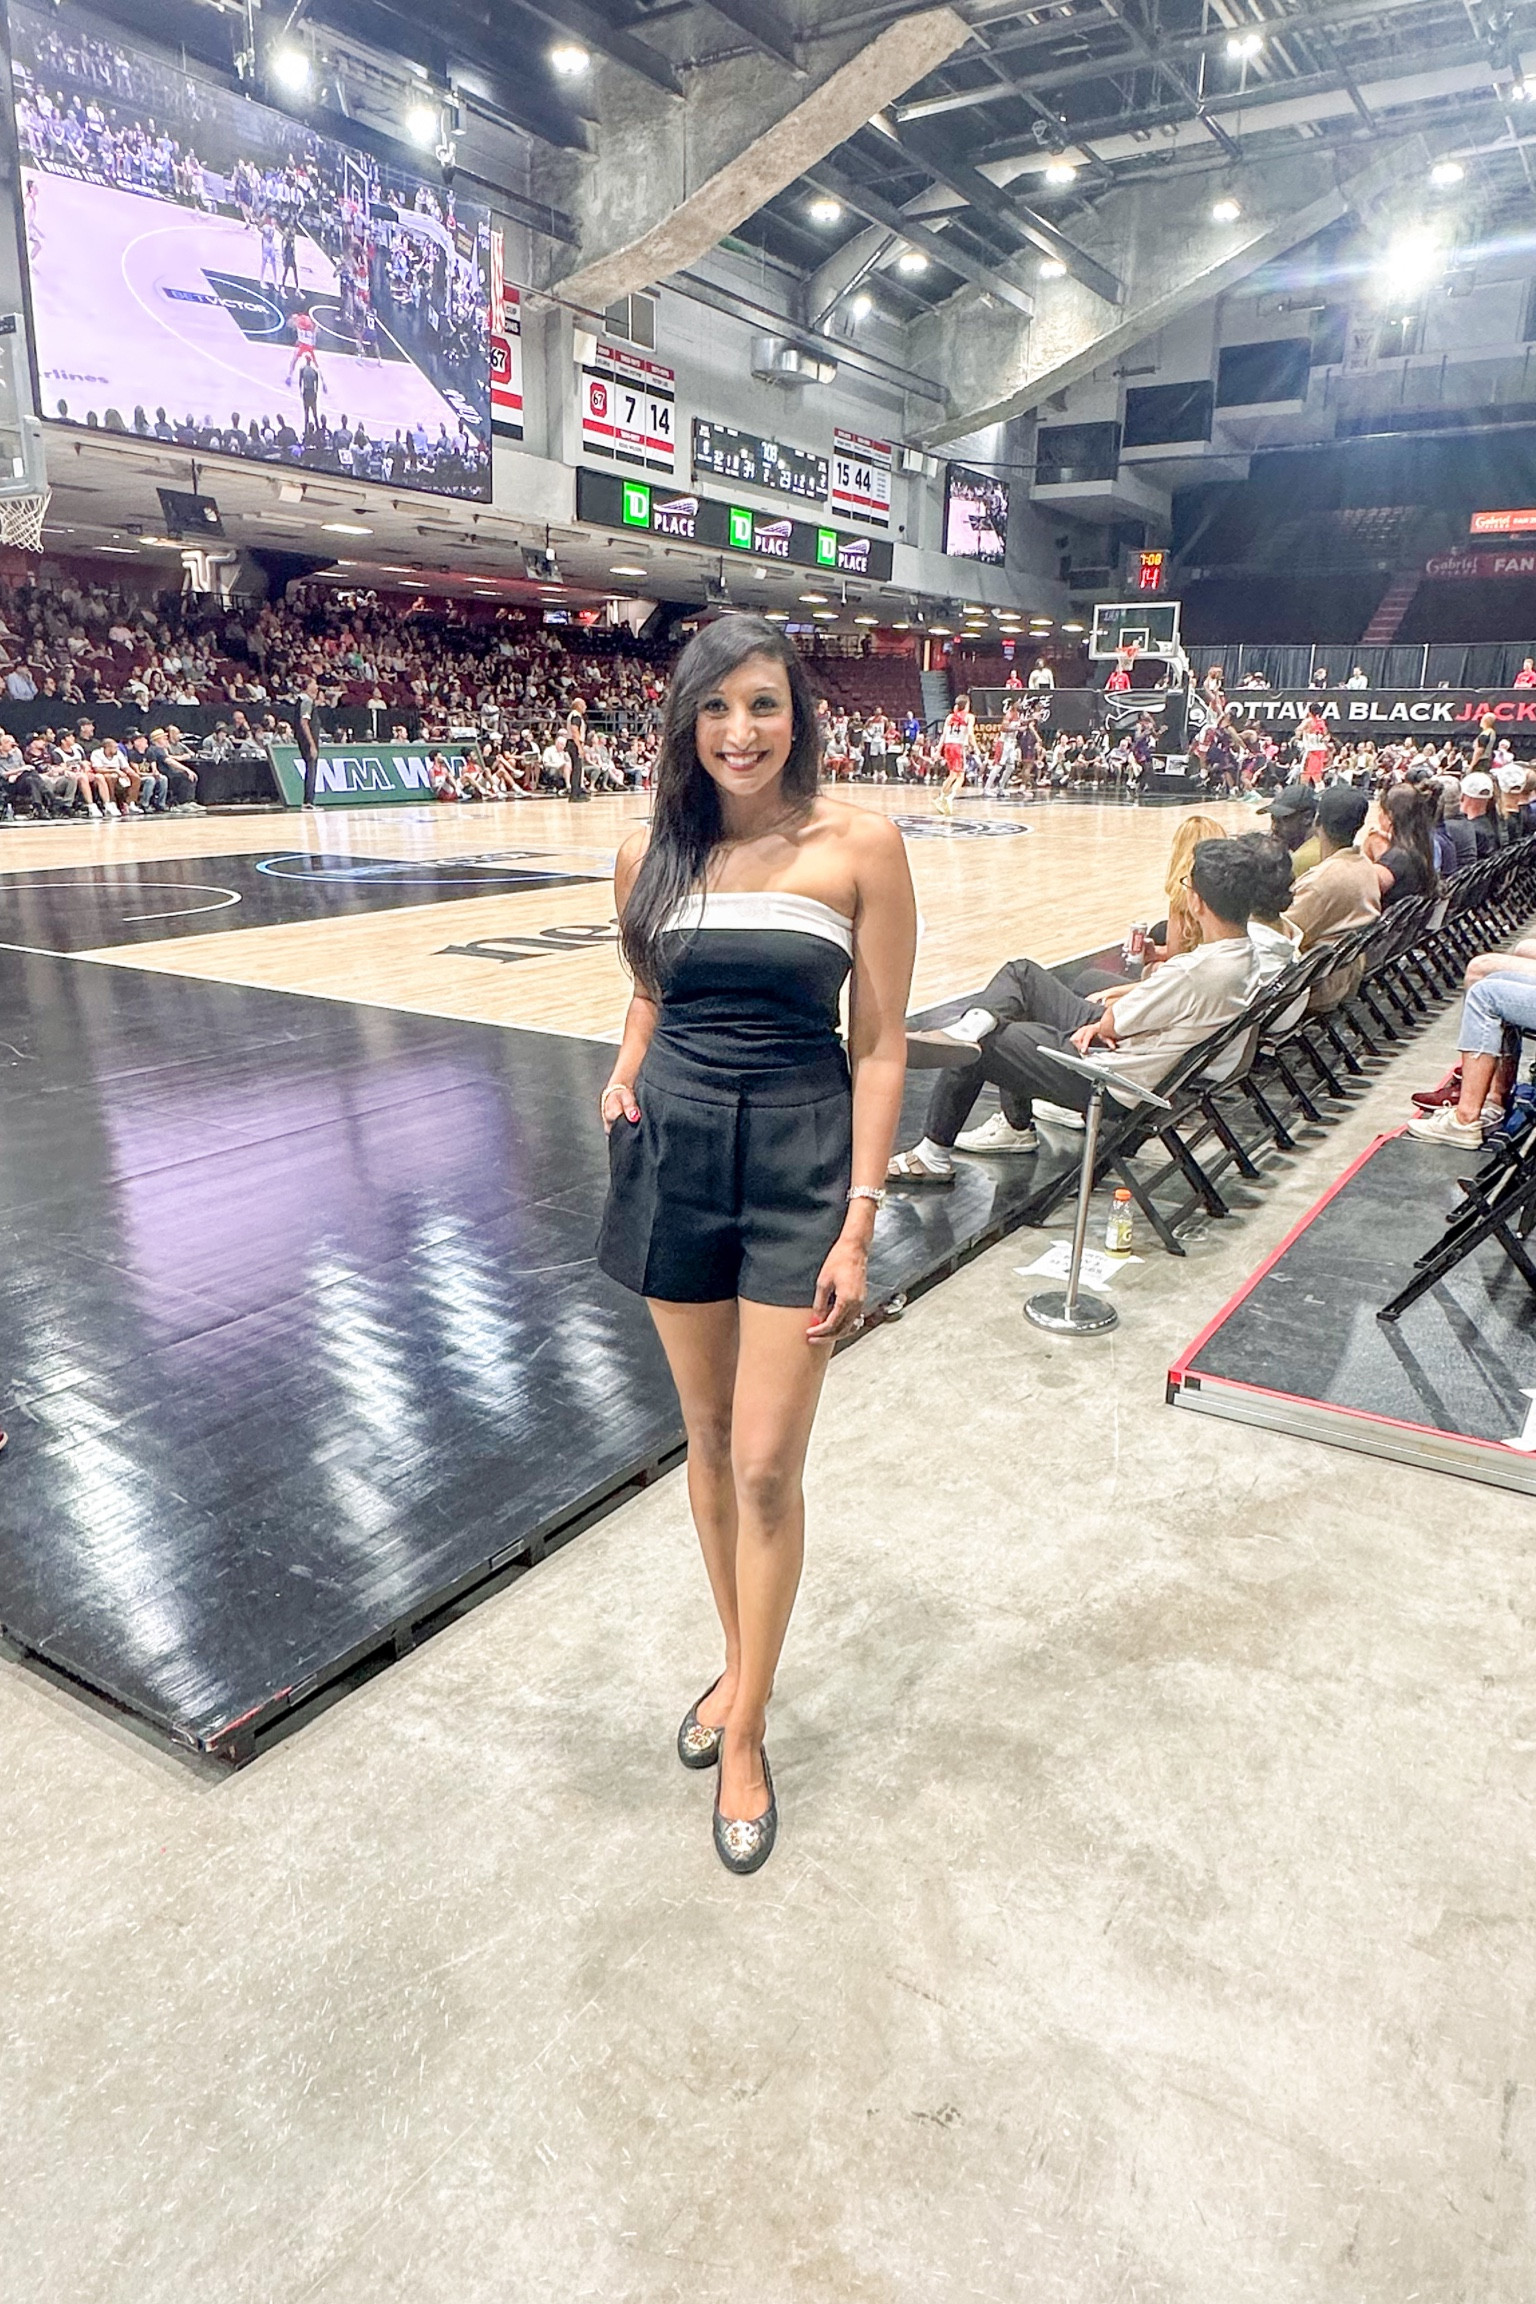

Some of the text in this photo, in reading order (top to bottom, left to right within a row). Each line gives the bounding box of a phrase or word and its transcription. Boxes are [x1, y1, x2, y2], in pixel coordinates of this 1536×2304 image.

[491, 348, 506, 369] 67
[625, 395, 636, 423] 7
[651, 404, 670, 434] 14
[837, 462, 850, 486] 15
[855, 468, 871, 492] 44
[626, 490, 695, 538] TD PLACE
[732, 515, 789, 557] TD PLACE
[820, 536, 867, 573] TD PLACE
[1426, 557, 1477, 574] Gabriel
[1494, 558, 1535, 572] FAN
[1226, 701, 1340, 720] OTTAWA
[294, 757, 391, 793] WM
